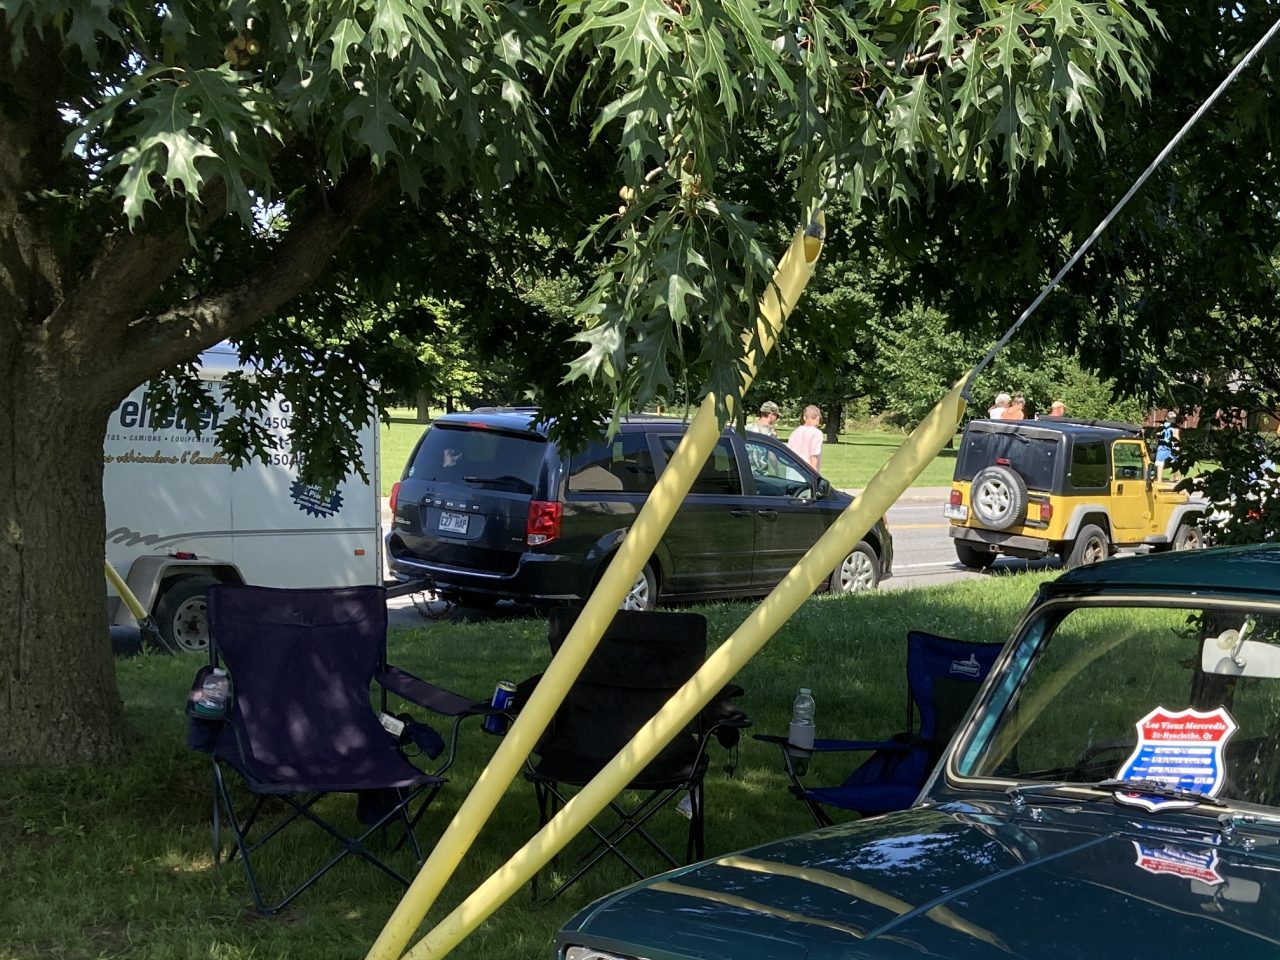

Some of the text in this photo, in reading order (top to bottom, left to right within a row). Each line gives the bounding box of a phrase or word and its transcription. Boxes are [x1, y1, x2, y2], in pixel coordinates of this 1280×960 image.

[129, 435, 162, 443] CAMIONS
[425, 497, 481, 511] DODGE
[1161, 721, 1184, 730] Vieux
